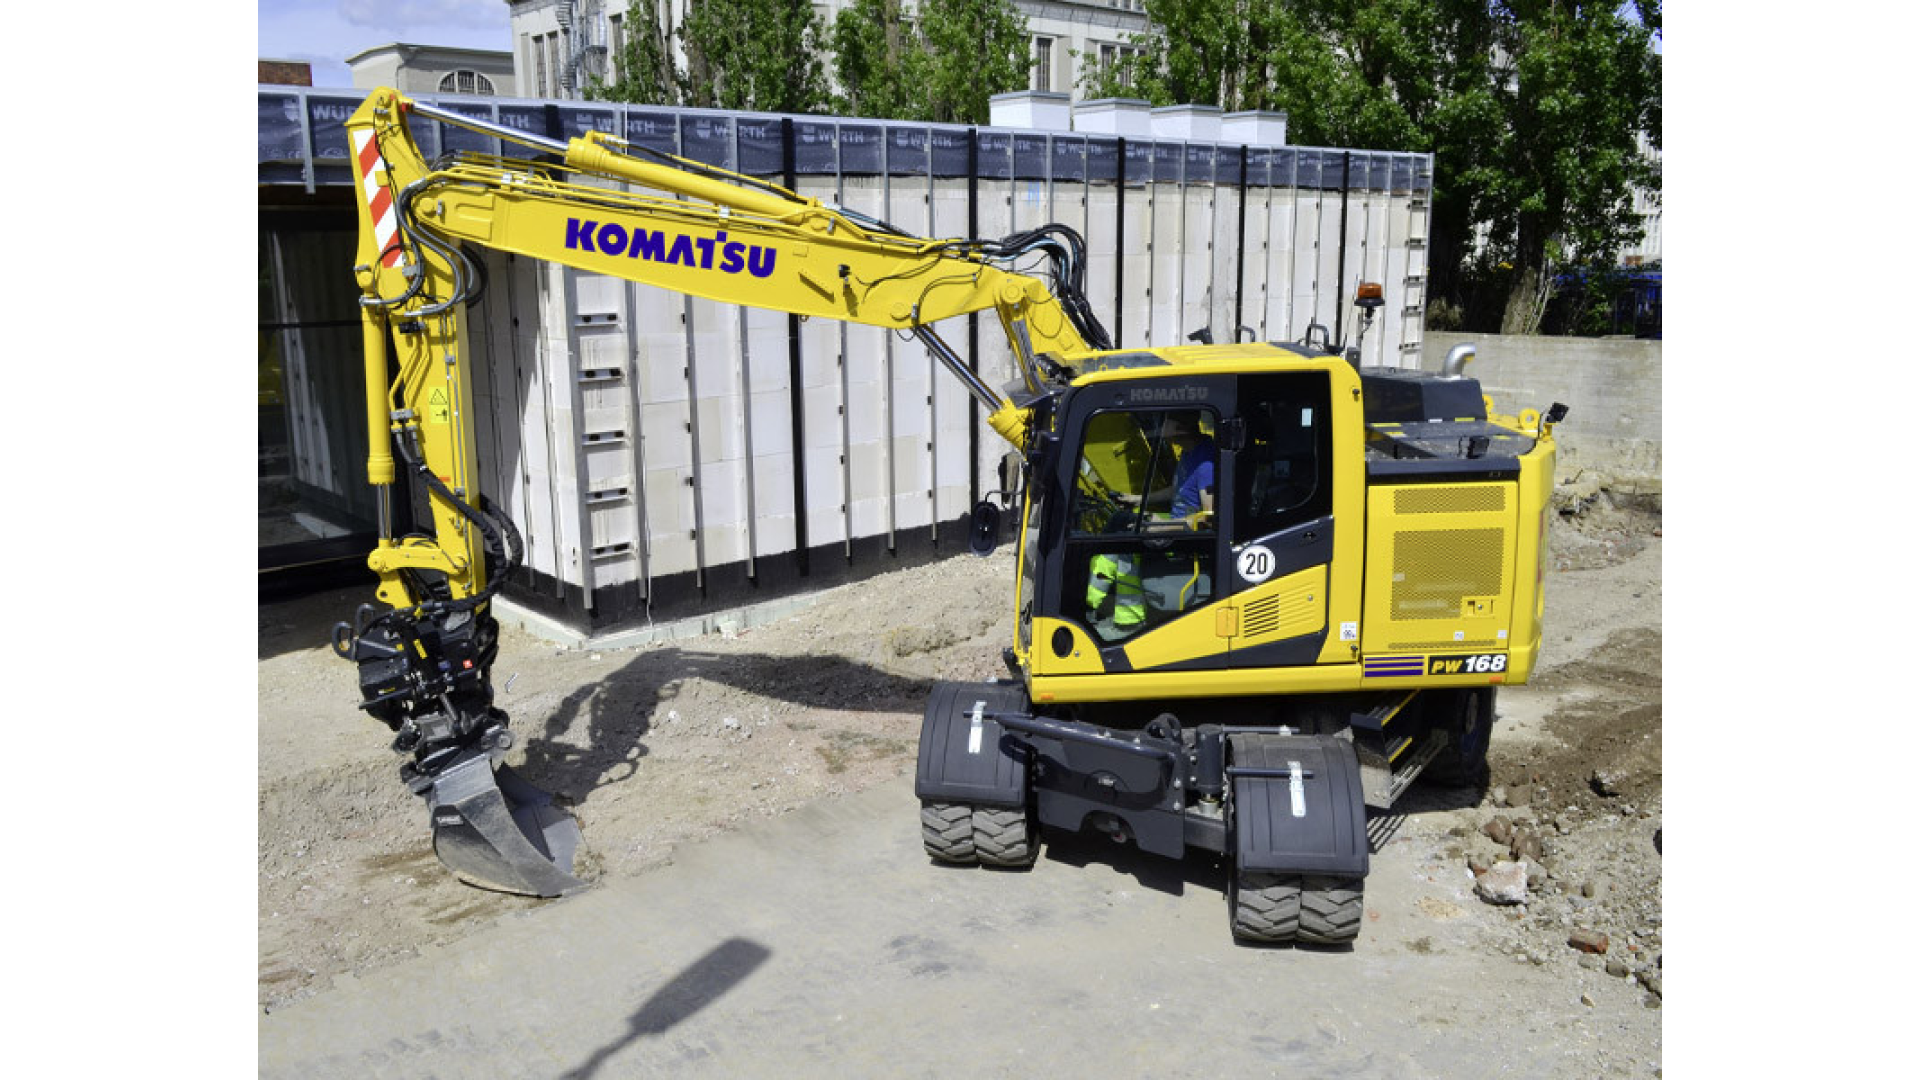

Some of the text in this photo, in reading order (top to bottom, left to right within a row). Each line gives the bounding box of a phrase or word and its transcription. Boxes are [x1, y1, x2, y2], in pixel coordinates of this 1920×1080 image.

[565, 217, 776, 278] KOMATSU
[1130, 384, 1208, 402] KOMATSU
[1245, 552, 1268, 575] 20
[1431, 655, 1507, 674] PW 168
